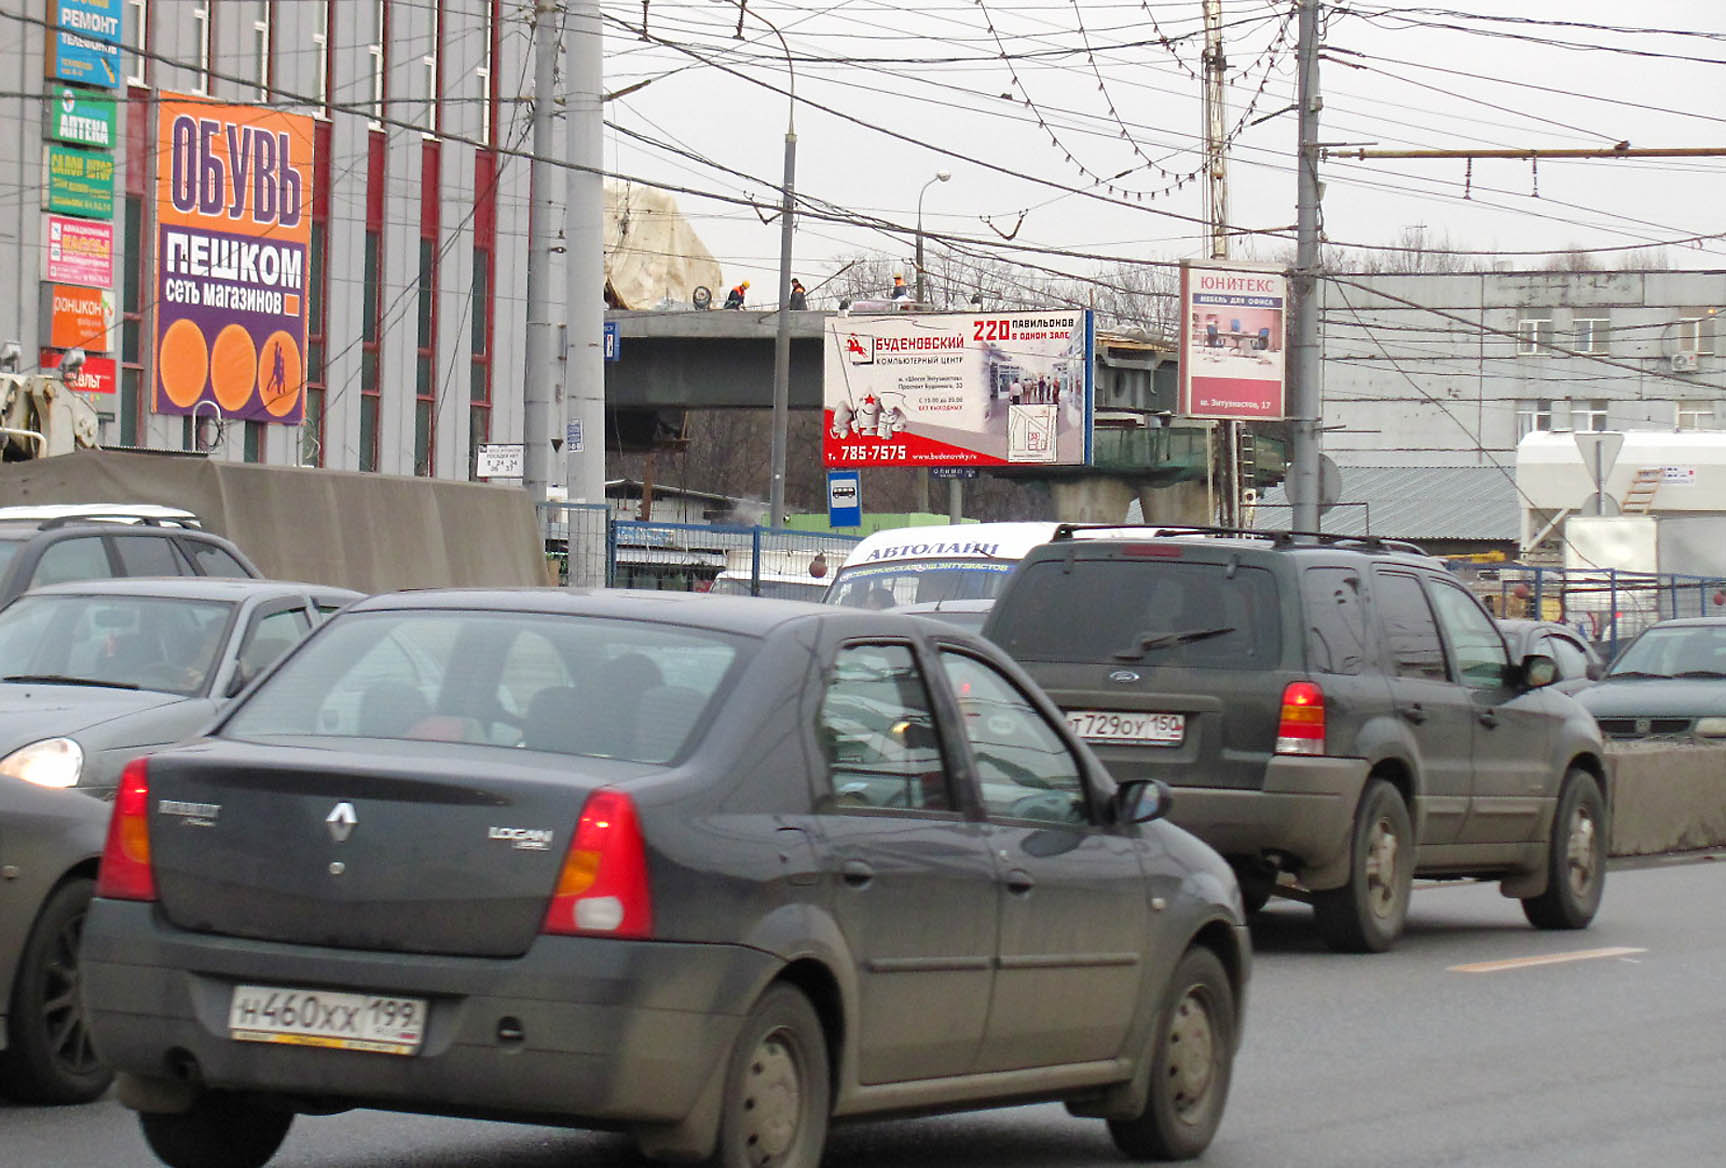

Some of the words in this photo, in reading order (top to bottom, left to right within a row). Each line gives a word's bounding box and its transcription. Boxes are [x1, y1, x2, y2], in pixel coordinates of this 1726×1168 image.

[62, 8, 118, 36] РЕМОНТ
[60, 114, 109, 145] АПТЕКА
[171, 114, 302, 228] ОБУВЬ
[167, 232, 301, 289] ПЕШКОМ
[1201, 276, 1275, 292] ЮНИТЕКС
[166, 278, 200, 305] сеть
[203, 283, 282, 315] магазинов
[1200, 295, 1228, 304] МЕБЕЛЬ
[1230, 297, 1246, 305] ДЛЯ
[1247, 298, 1275, 306] ОФИСА
[973, 321, 1010, 341] 220
[1012, 318, 1074, 329] ПАВИЛЬОНОВ
[1020, 332, 1048, 341] ОДНОМ
[1049, 331, 1071, 340] ЗАЛЕ
[876, 333, 965, 352] БУДЕНОВСКИЙ
[876, 356, 939, 366] КОМПЬЮТЕРНЫЙ
[941, 356, 964, 366] ЦЕНТР
[1261, 401, 1271, 409] 17
[841, 445, 906, 460] 785-7575
[1151, 715, 1179, 731] 150
[488, 826, 553, 842] LOGAN
[368, 999, 416, 1028] 199
